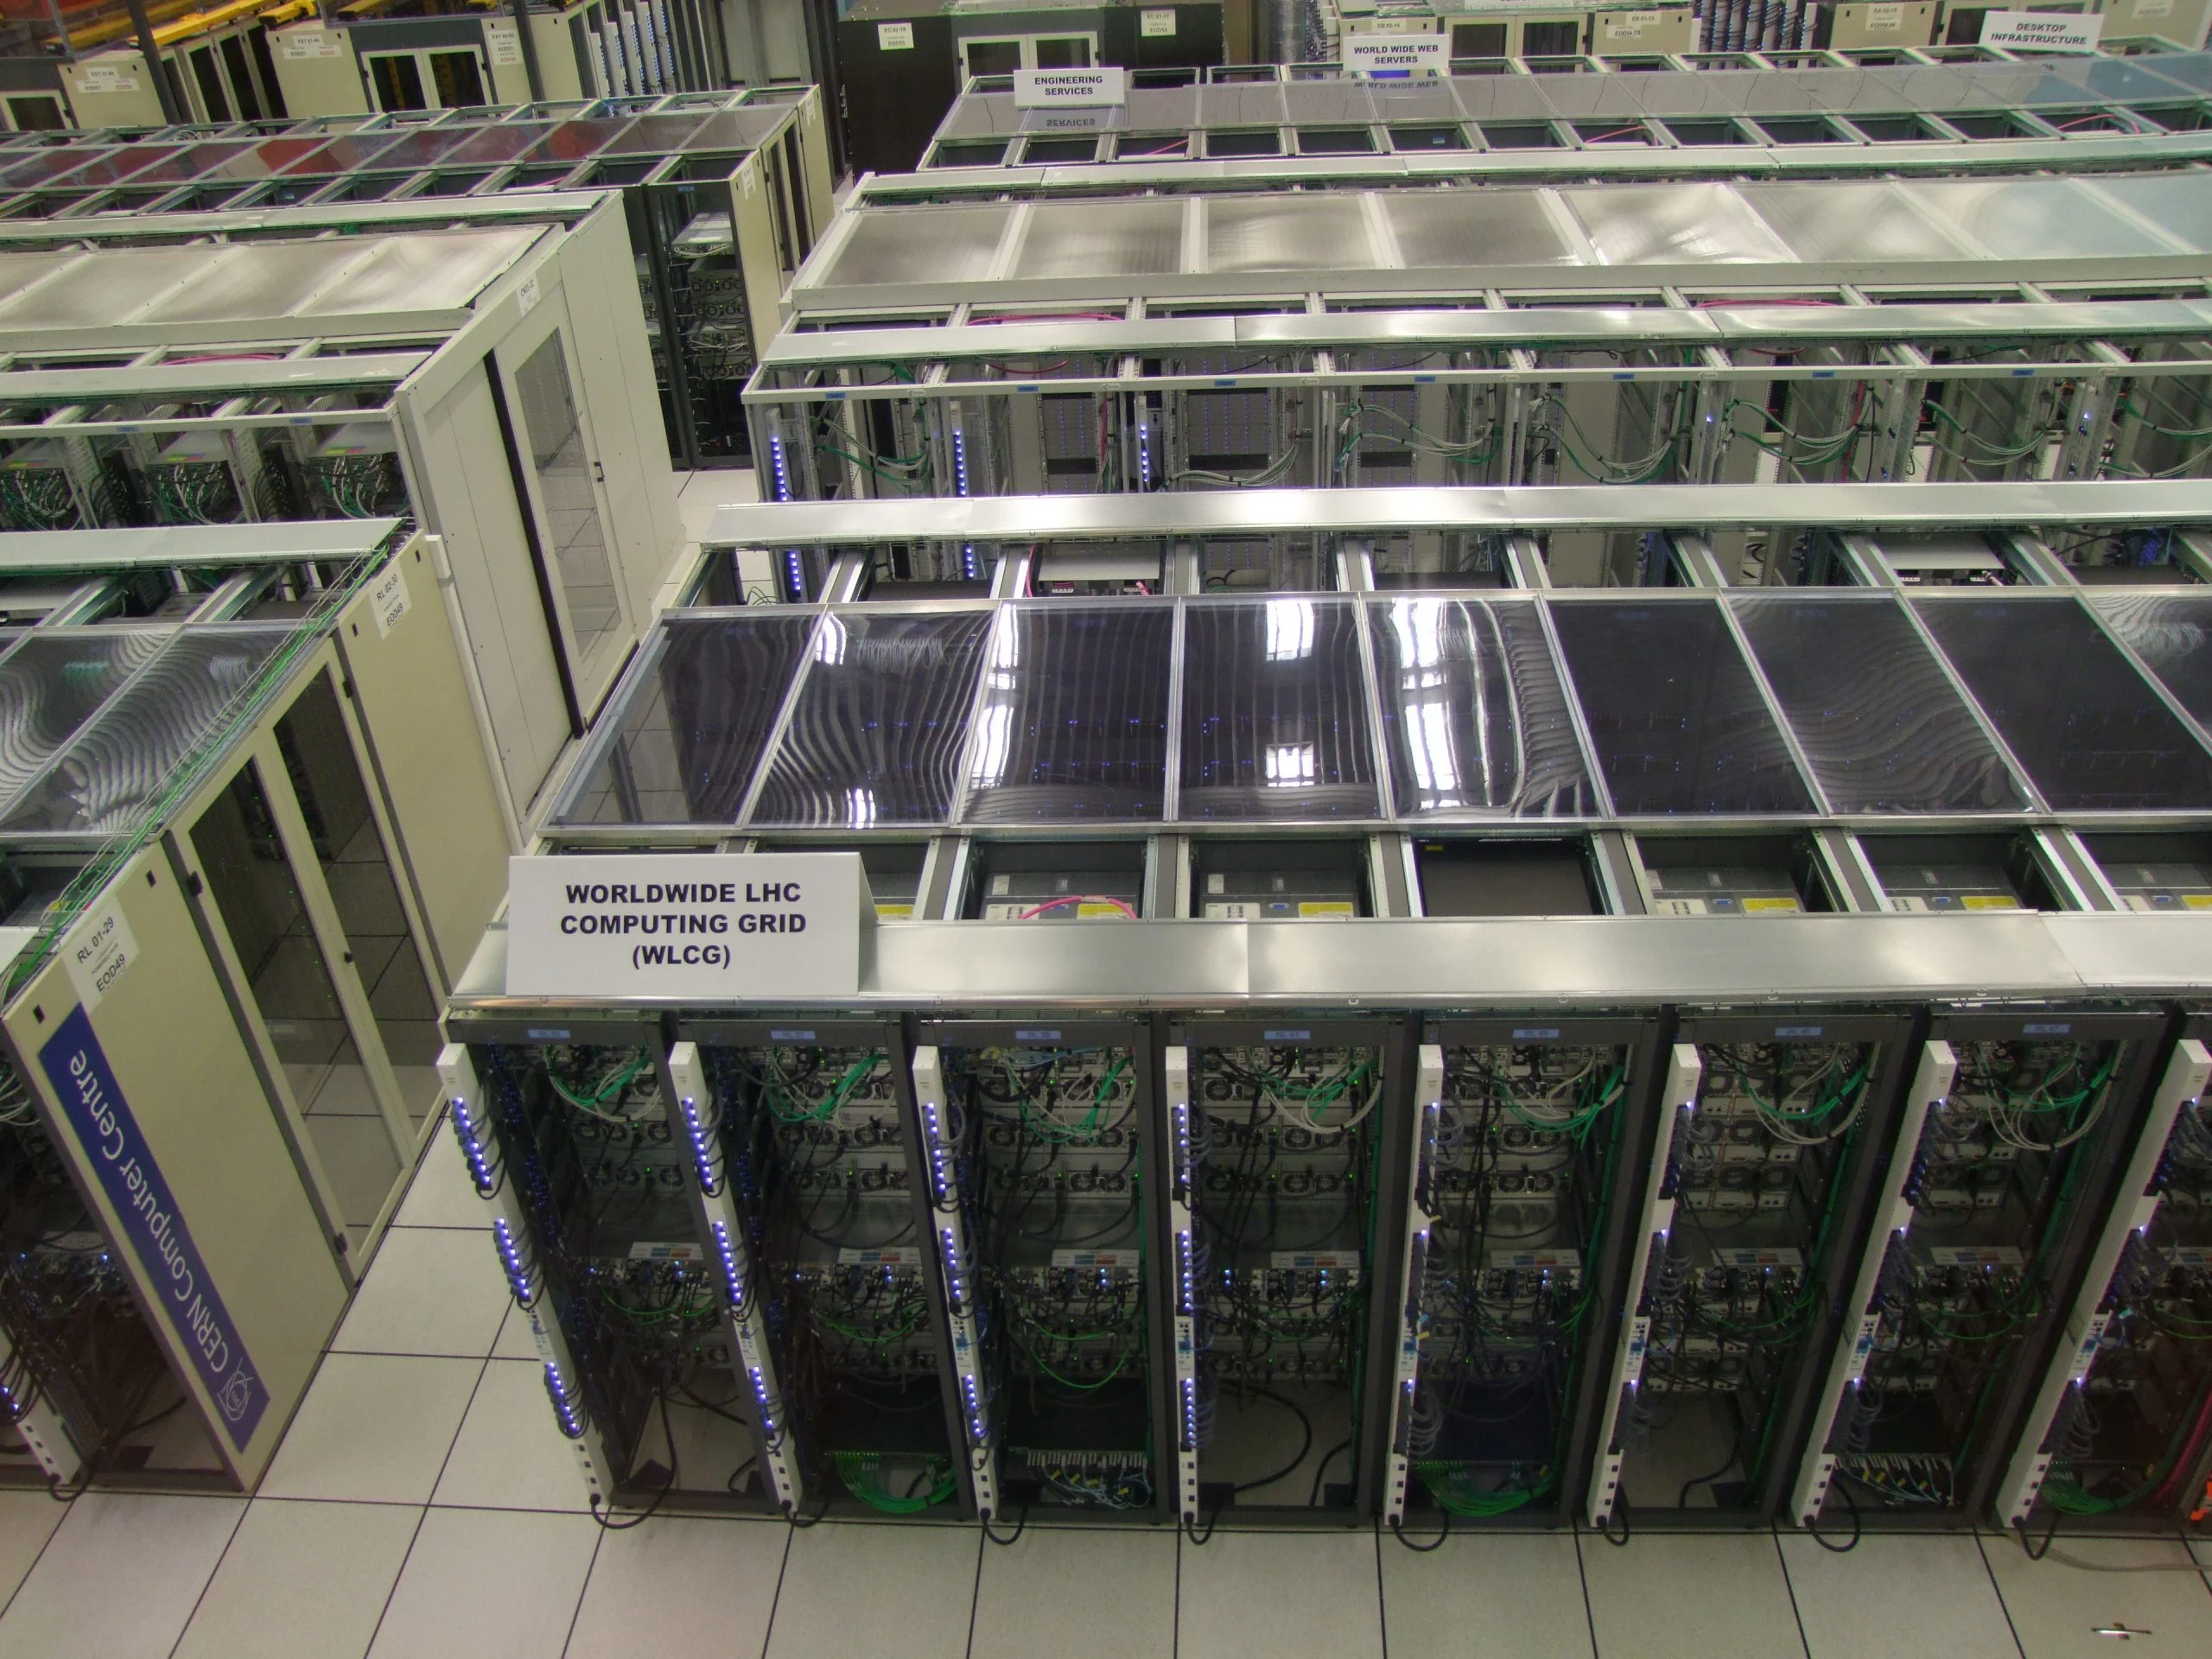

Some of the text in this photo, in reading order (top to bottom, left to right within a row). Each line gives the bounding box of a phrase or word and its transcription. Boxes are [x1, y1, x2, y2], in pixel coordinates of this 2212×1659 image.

[2016, 22, 2067, 32] DESKTOP
[1354, 46, 1388, 54] WORLD
[1418, 44, 1439, 53] WEB
[1991, 33, 2088, 45] INFRASTRUCTURE
[1034, 76, 1103, 85] ENGINEERING
[1045, 87, 1093, 96] SERVICES
[566, 883, 801, 904] WORLDWIDE LHC
[561, 914, 806, 934] COMPUTING GRID
[77, 917, 114, 963] RL 01-29
[632, 944, 731, 969] (WLCG)
[96, 953, 126, 992] EOD49
[71, 1050, 228, 1372] CERN Computer Centre
